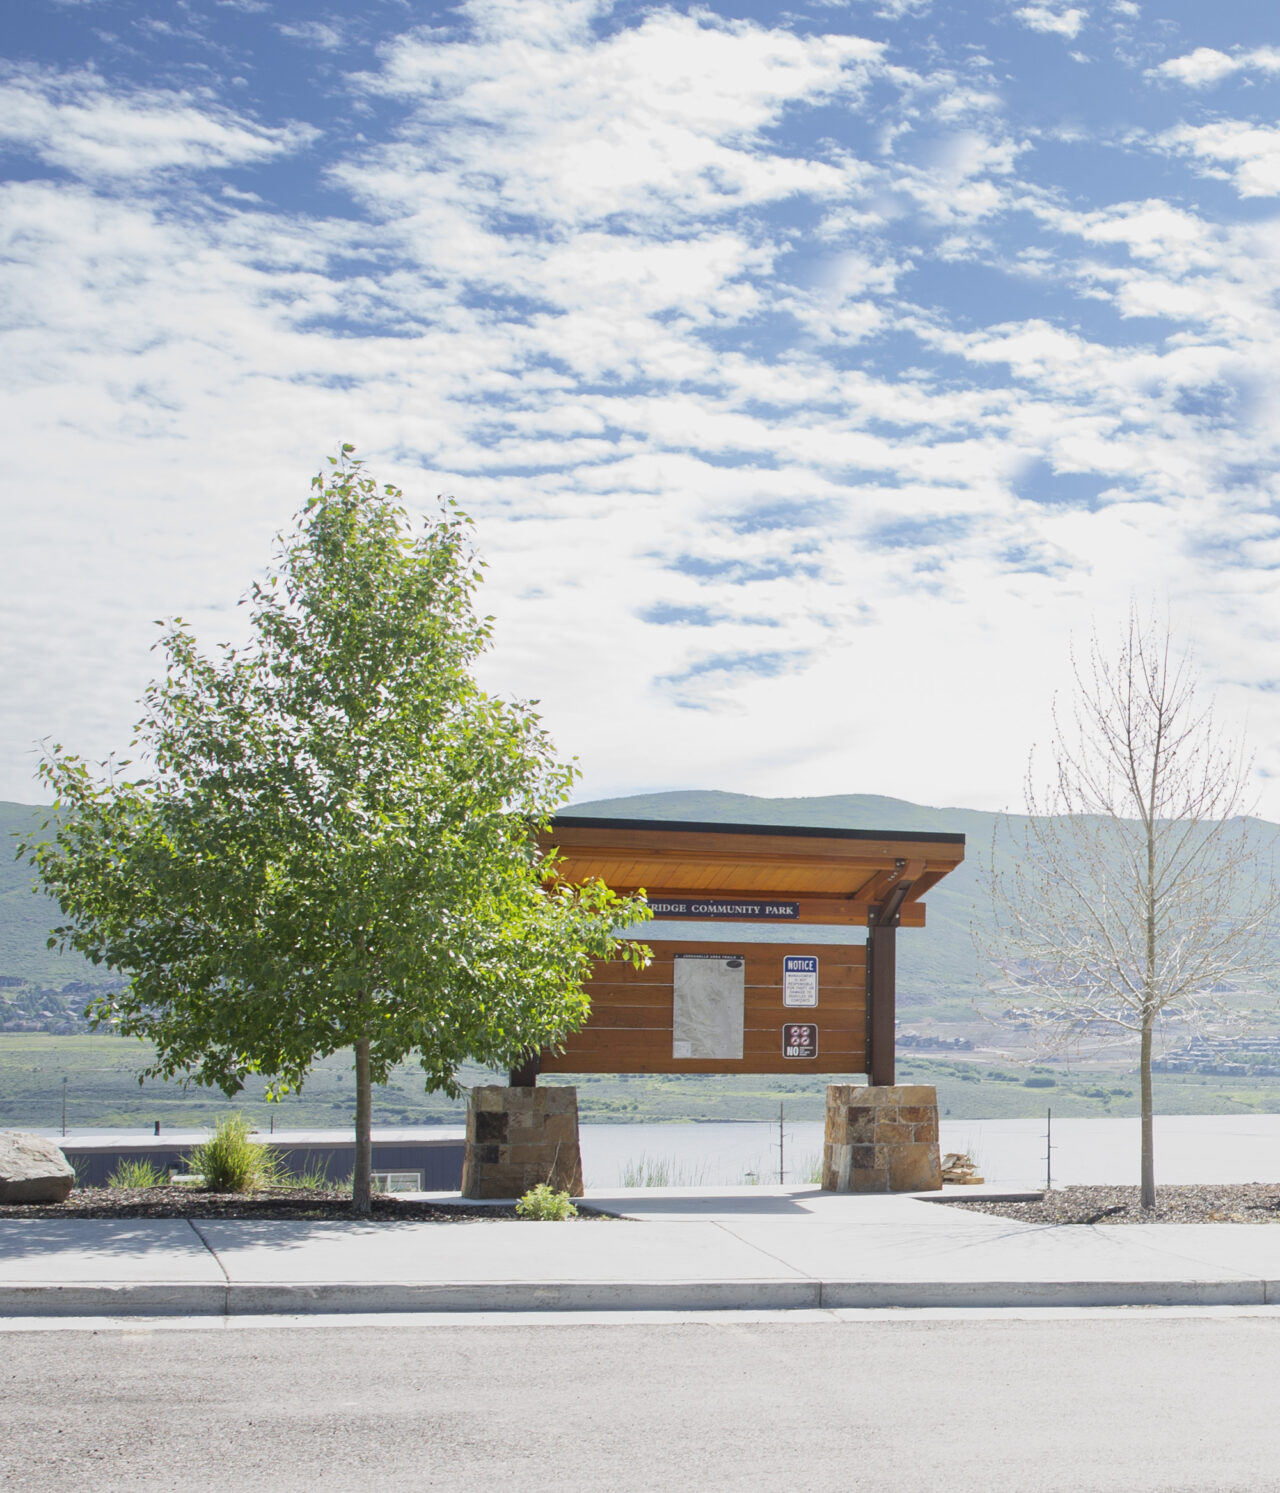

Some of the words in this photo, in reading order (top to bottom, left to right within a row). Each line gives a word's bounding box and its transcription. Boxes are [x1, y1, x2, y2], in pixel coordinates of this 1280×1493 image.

[691, 904, 760, 914] COMMUNITY
[765, 906, 793, 915] PARK
[787, 960, 814, 970] NOTICE
[786, 1046, 799, 1056] NO
